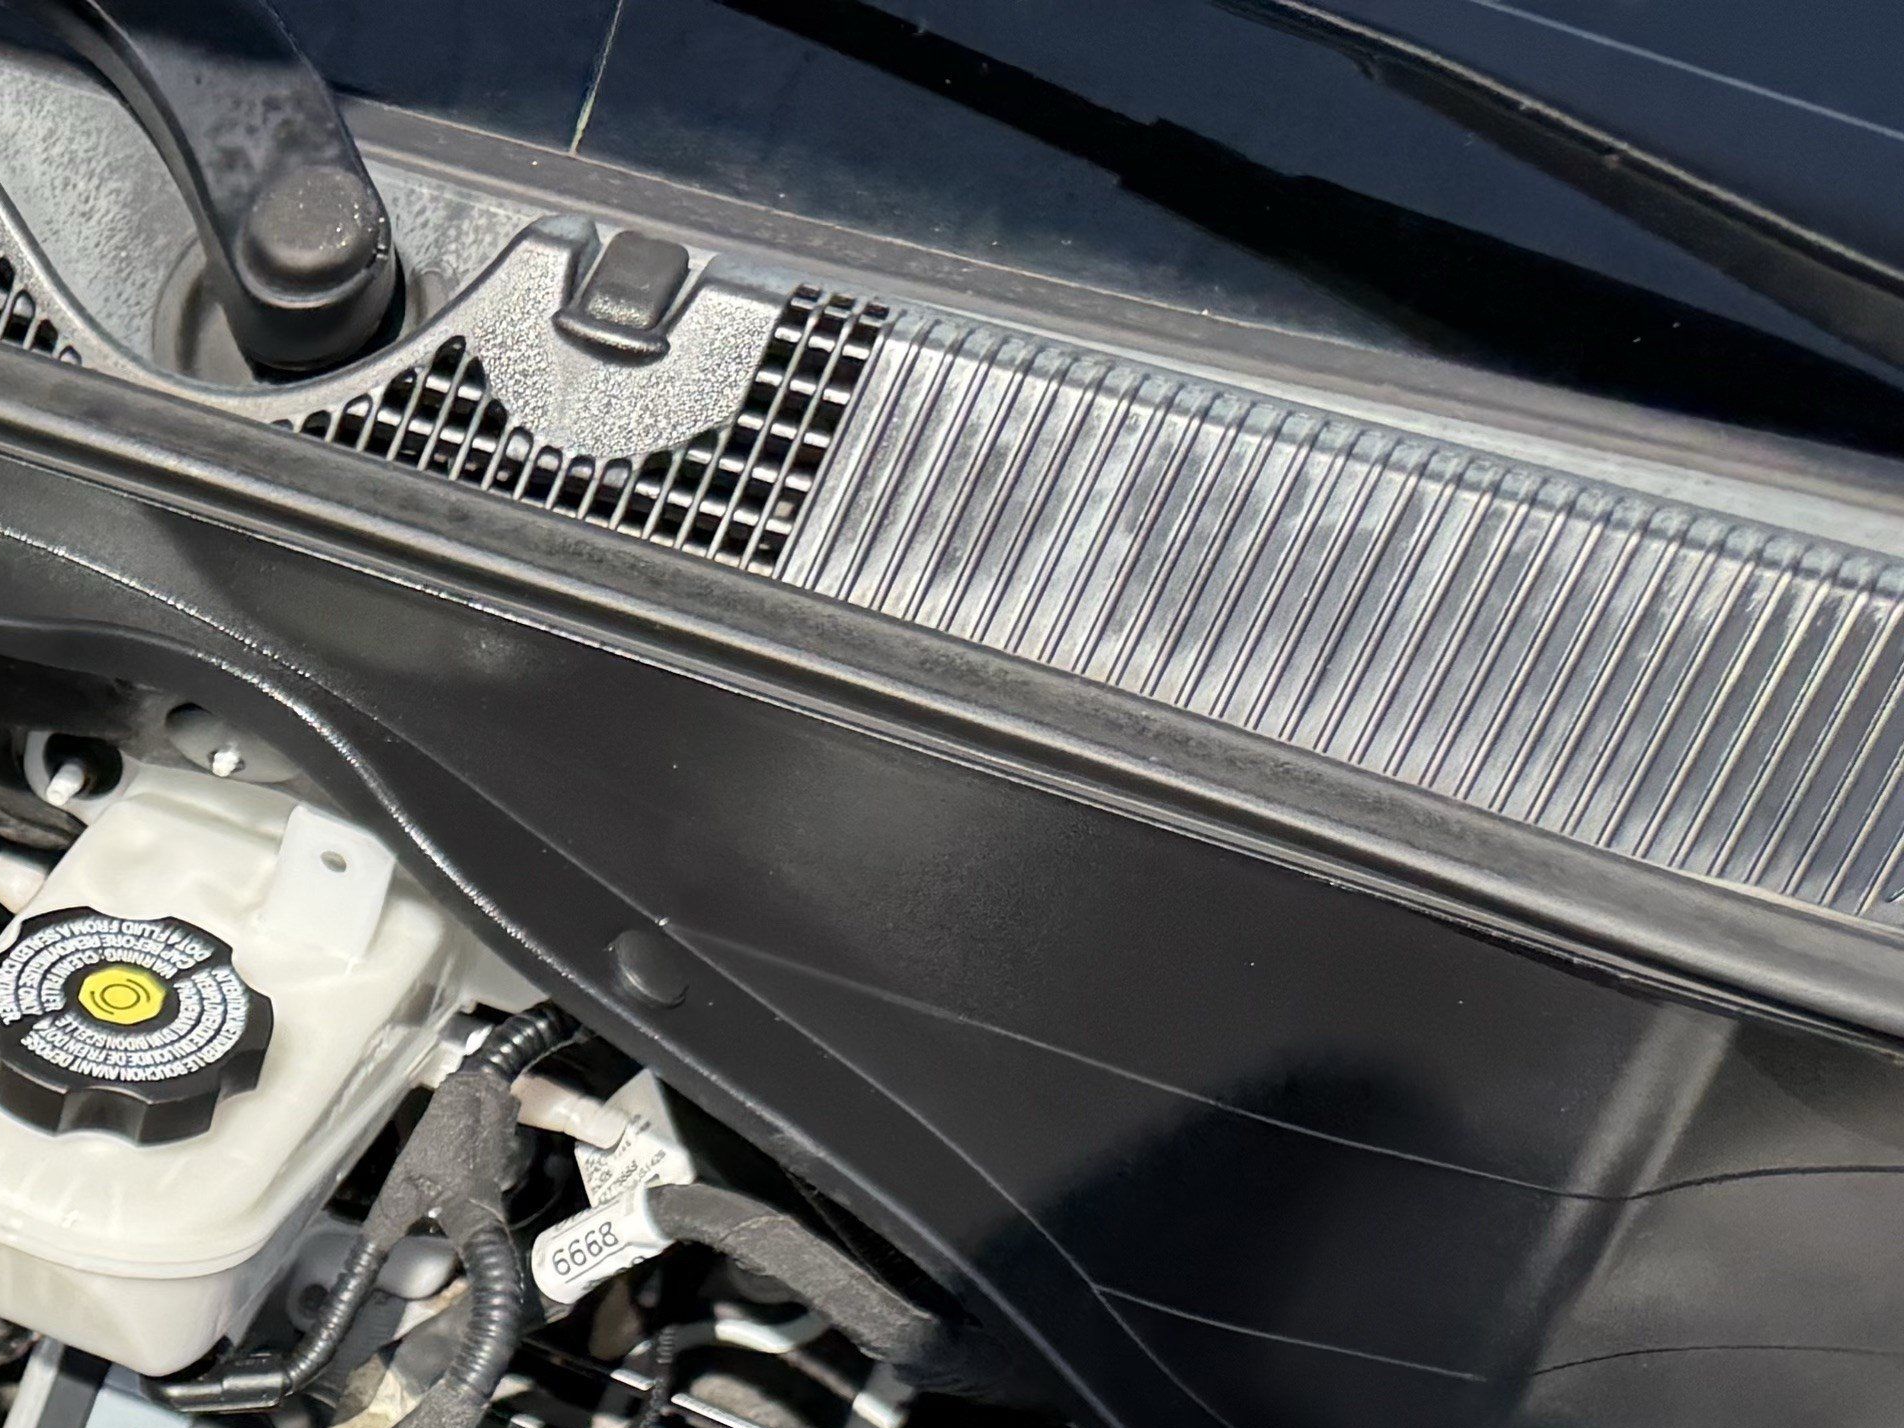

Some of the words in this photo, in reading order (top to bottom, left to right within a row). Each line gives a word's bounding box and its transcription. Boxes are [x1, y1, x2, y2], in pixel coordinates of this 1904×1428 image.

[68, 917, 119, 935] FROM
[122, 919, 170, 941] FLUID
[6, 927, 62, 962] SEALED
[99, 933, 166, 955] BEFORE
[48, 949, 100, 978] CLEAN
[158, 944, 199, 970] CAP
[18, 986, 41, 1017] ONLY
[41, 973, 65, 1011] FILLER
[51, 1014, 107, 1048] SCELLE
[103, 1035, 150, 1050] BIDON
[60, 1038, 107, 1063] FREIN
[105, 1050, 125, 1065] DE
[126, 1045, 182, 1065] LIQUIDE
[179, 1053, 207, 1071] LE
[68, 1057, 119, 1080] AVANT
[120, 1060, 189, 1080] BOUCHON
[552, 1221, 619, 1276] 6668
